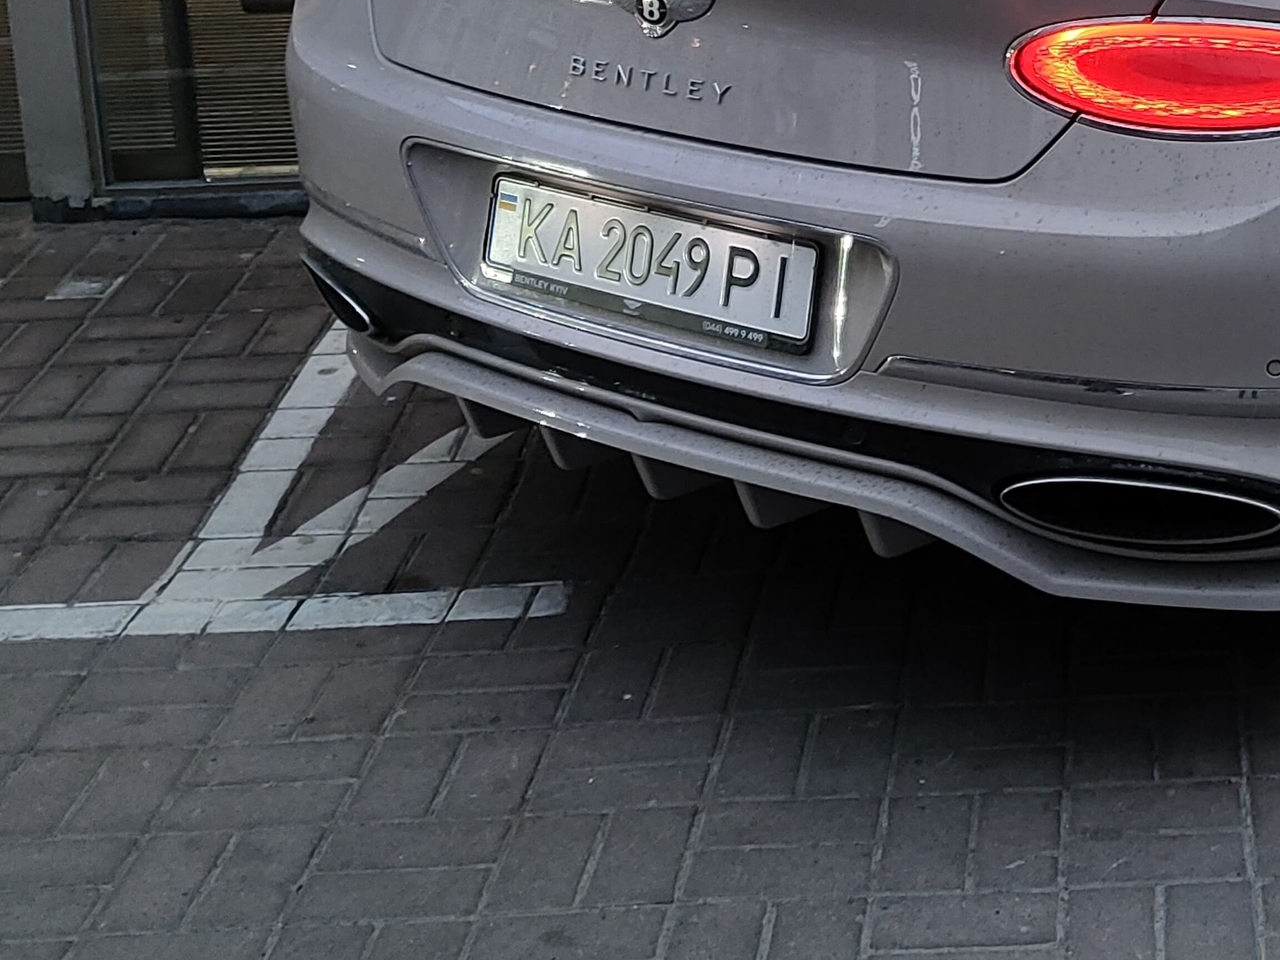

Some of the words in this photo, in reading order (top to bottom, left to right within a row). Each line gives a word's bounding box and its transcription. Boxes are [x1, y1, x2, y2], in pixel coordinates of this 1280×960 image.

[568, 53, 733, 105] BENTLEY
[516, 197, 583, 275] KA
[594, 217, 711, 299] 2049
[719, 244, 789, 319] PI
[514, 273, 549, 290] BENTLEY
[740, 329, 747, 339] 9
